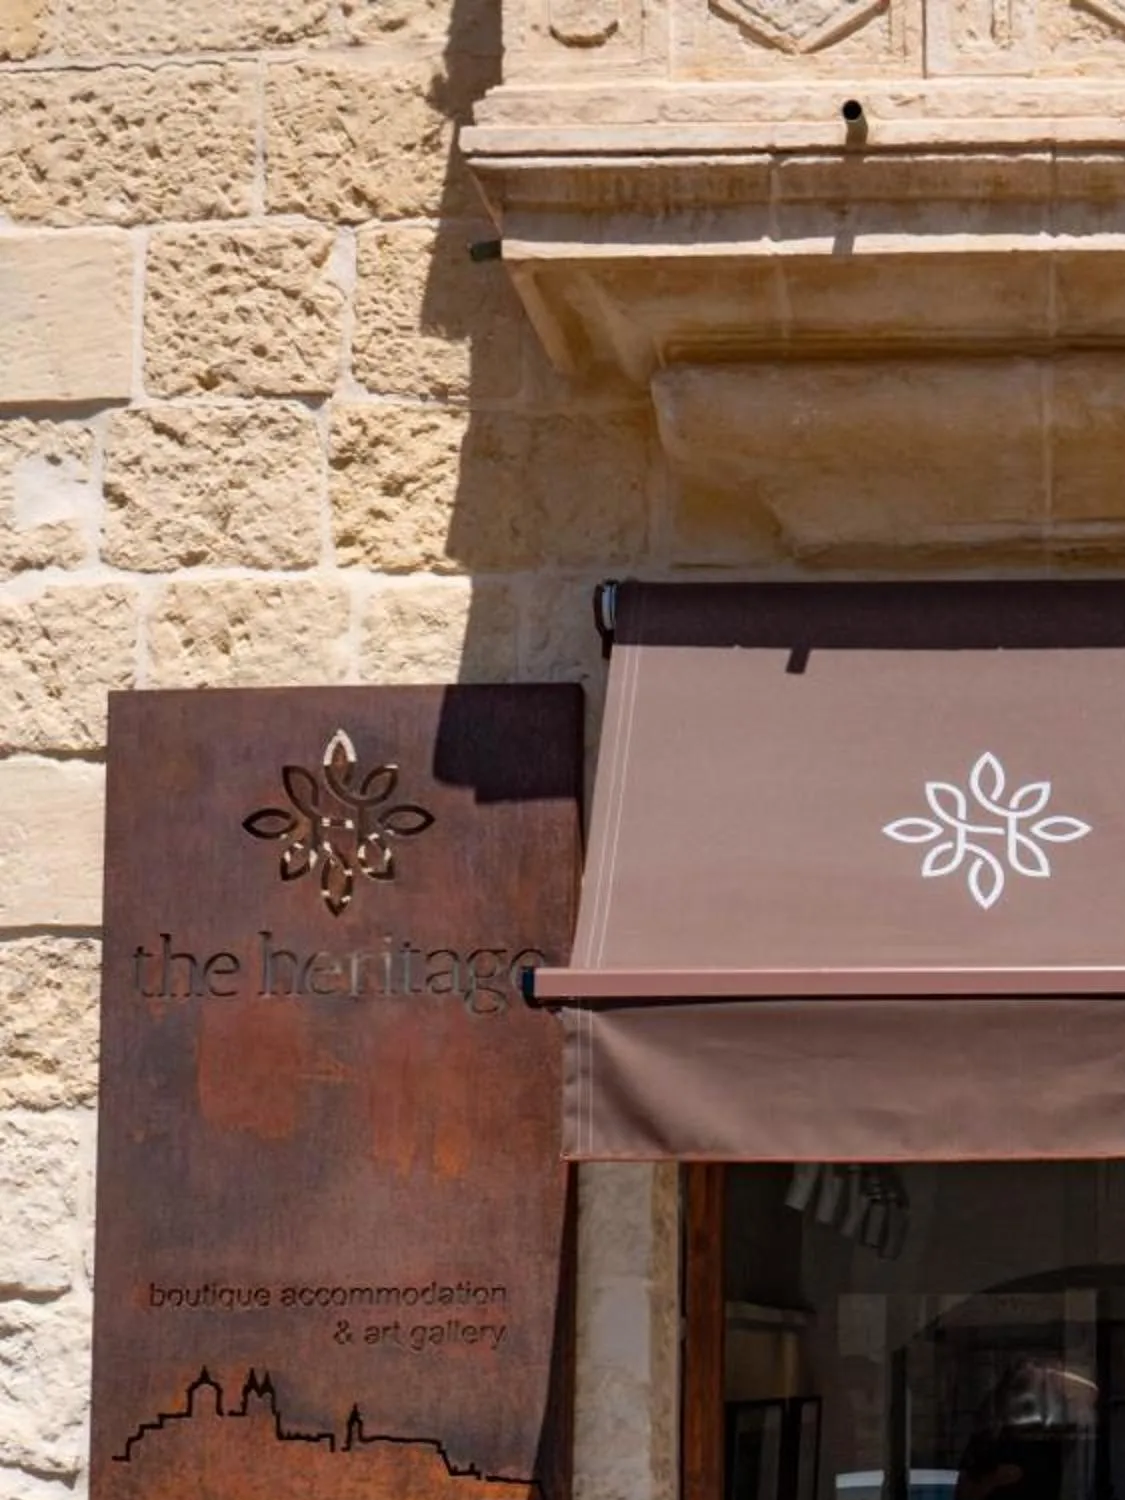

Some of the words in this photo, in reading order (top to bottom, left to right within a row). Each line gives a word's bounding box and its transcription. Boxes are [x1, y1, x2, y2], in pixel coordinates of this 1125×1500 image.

[133, 932, 239, 999] the
[149, 1282, 271, 1313] boutique
[280, 1281, 507, 1307] accommodation
[333, 1319, 354, 1345] &
[363, 1320, 402, 1345] art
[409, 1319, 507, 1351] gallery
